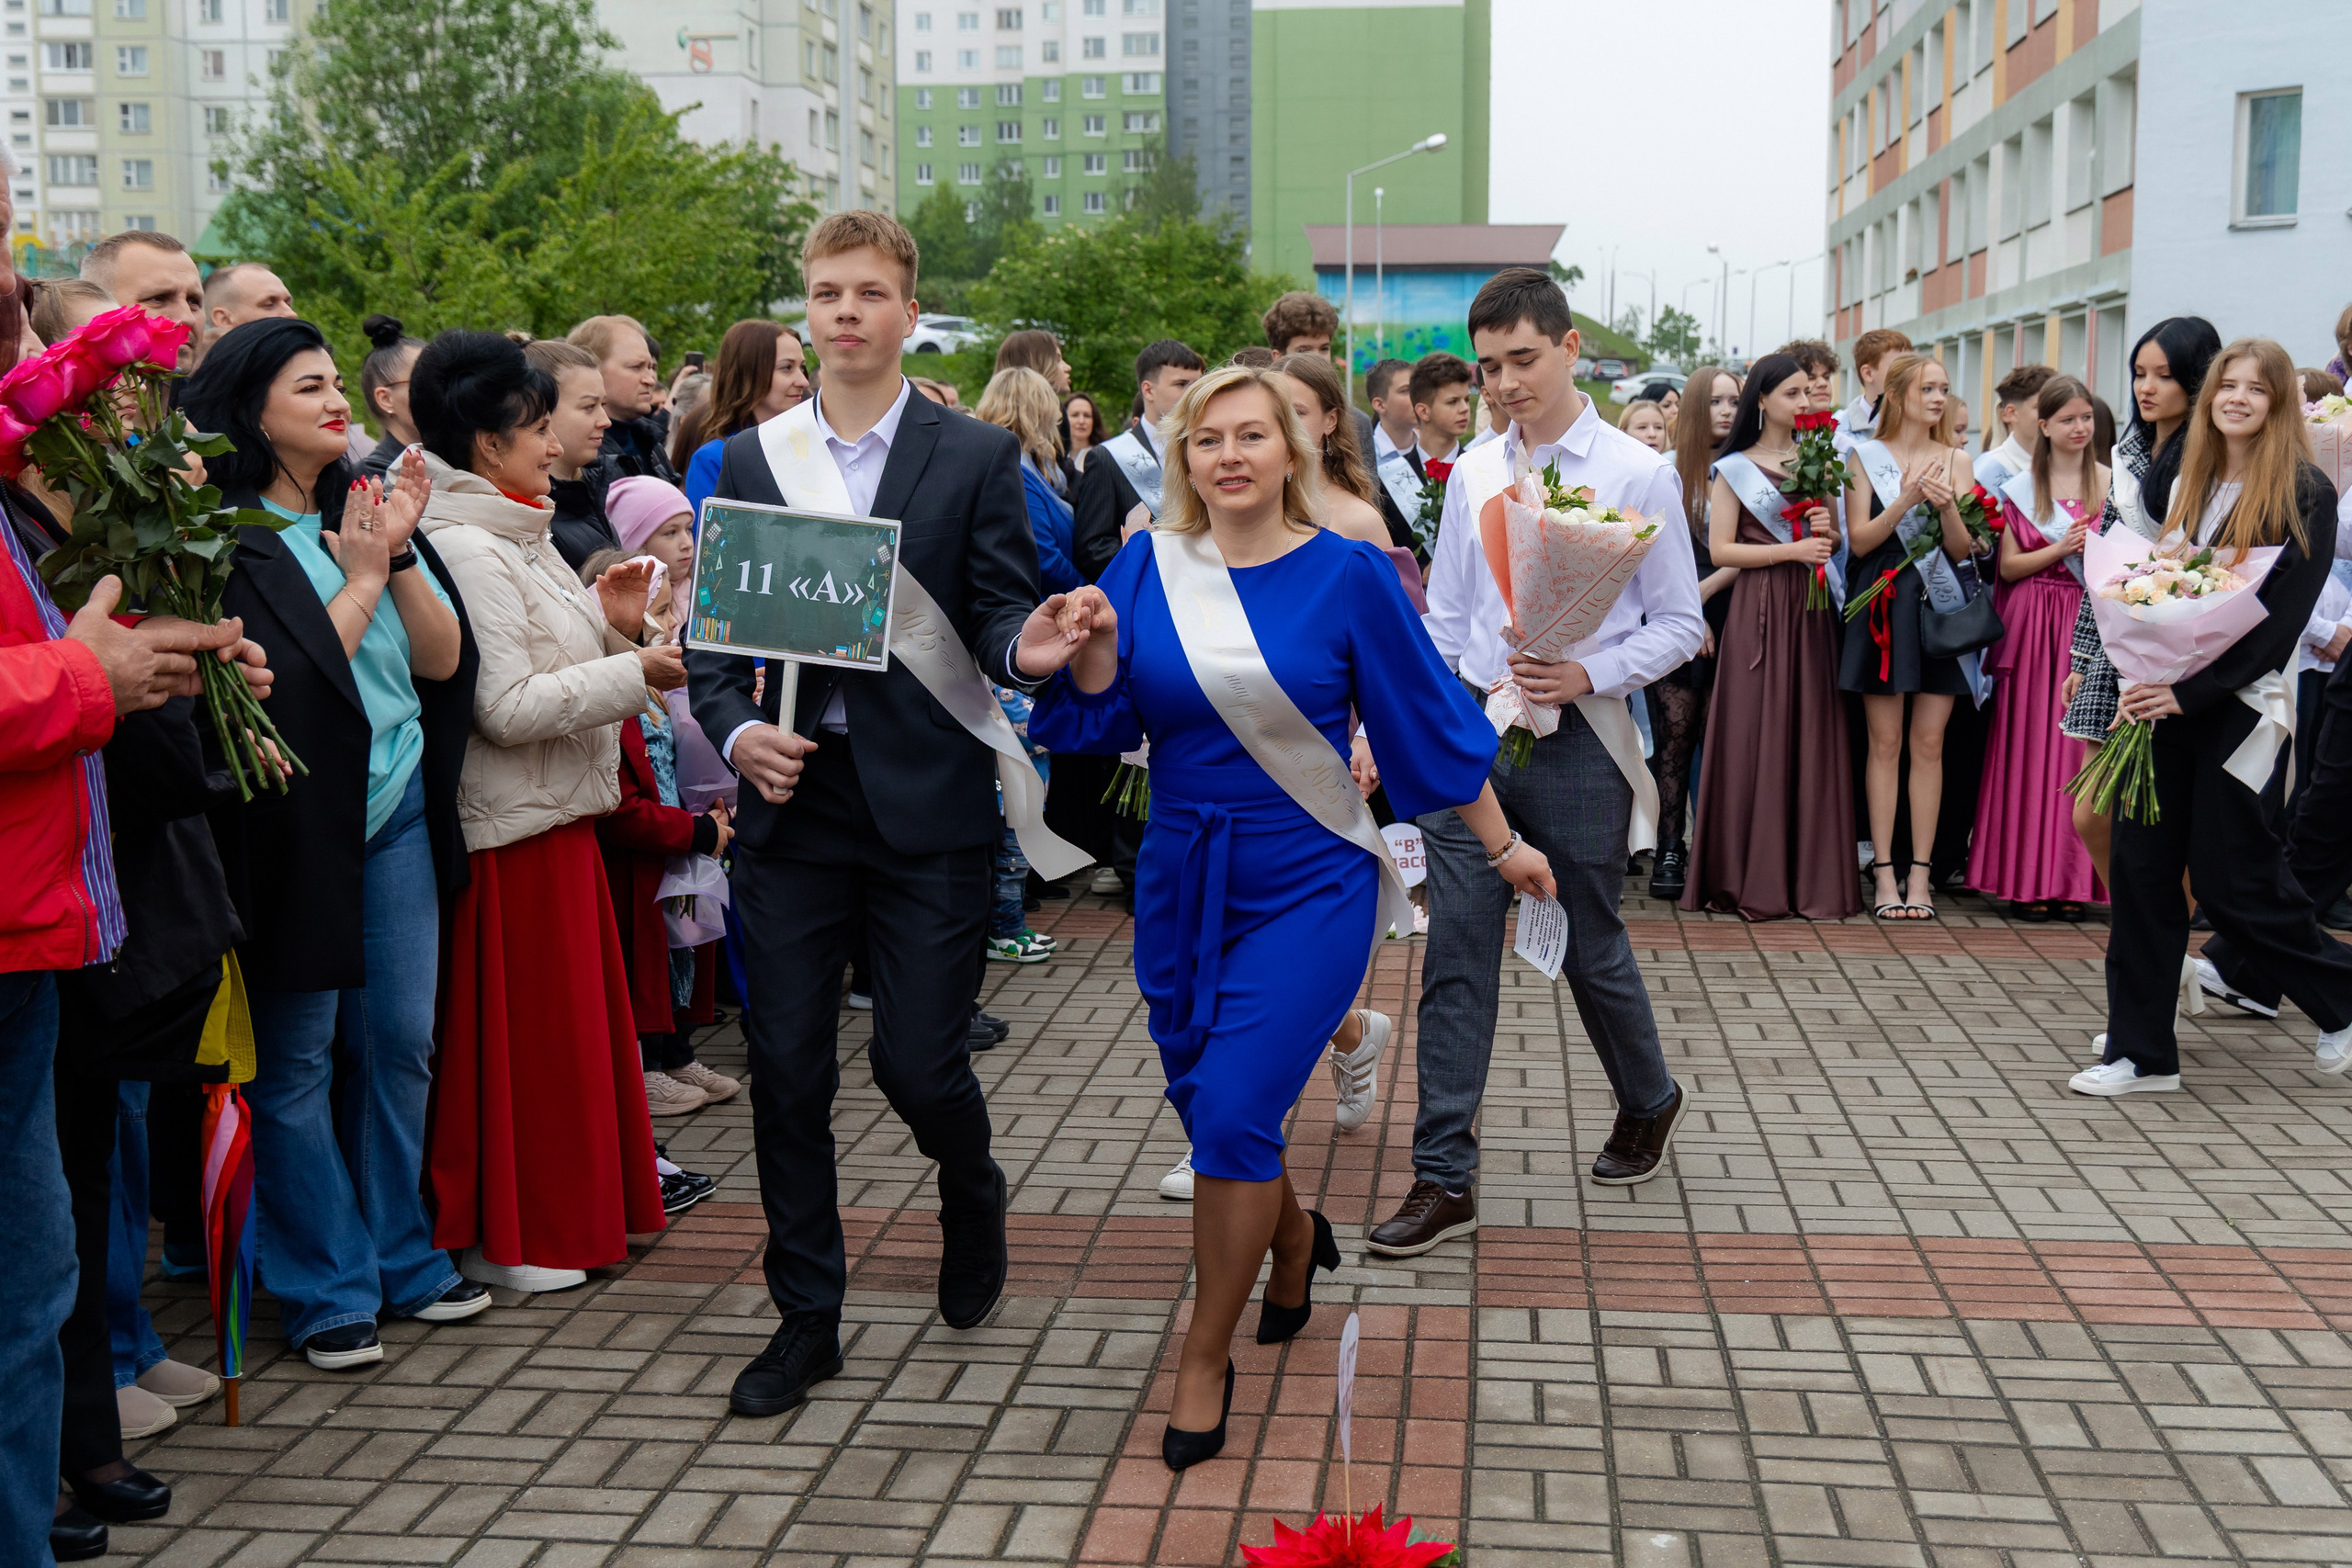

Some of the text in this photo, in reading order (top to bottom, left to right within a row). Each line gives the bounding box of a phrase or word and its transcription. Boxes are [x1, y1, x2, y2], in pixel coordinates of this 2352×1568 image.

[2321, 423, 2335, 456] OVE
[735, 559, 865, 606] 11 «А»
[1529, 589, 1611, 660] OMANTIC
[1609, 540, 1653, 584] LOV
[1300, 757, 1348, 805] 2025
